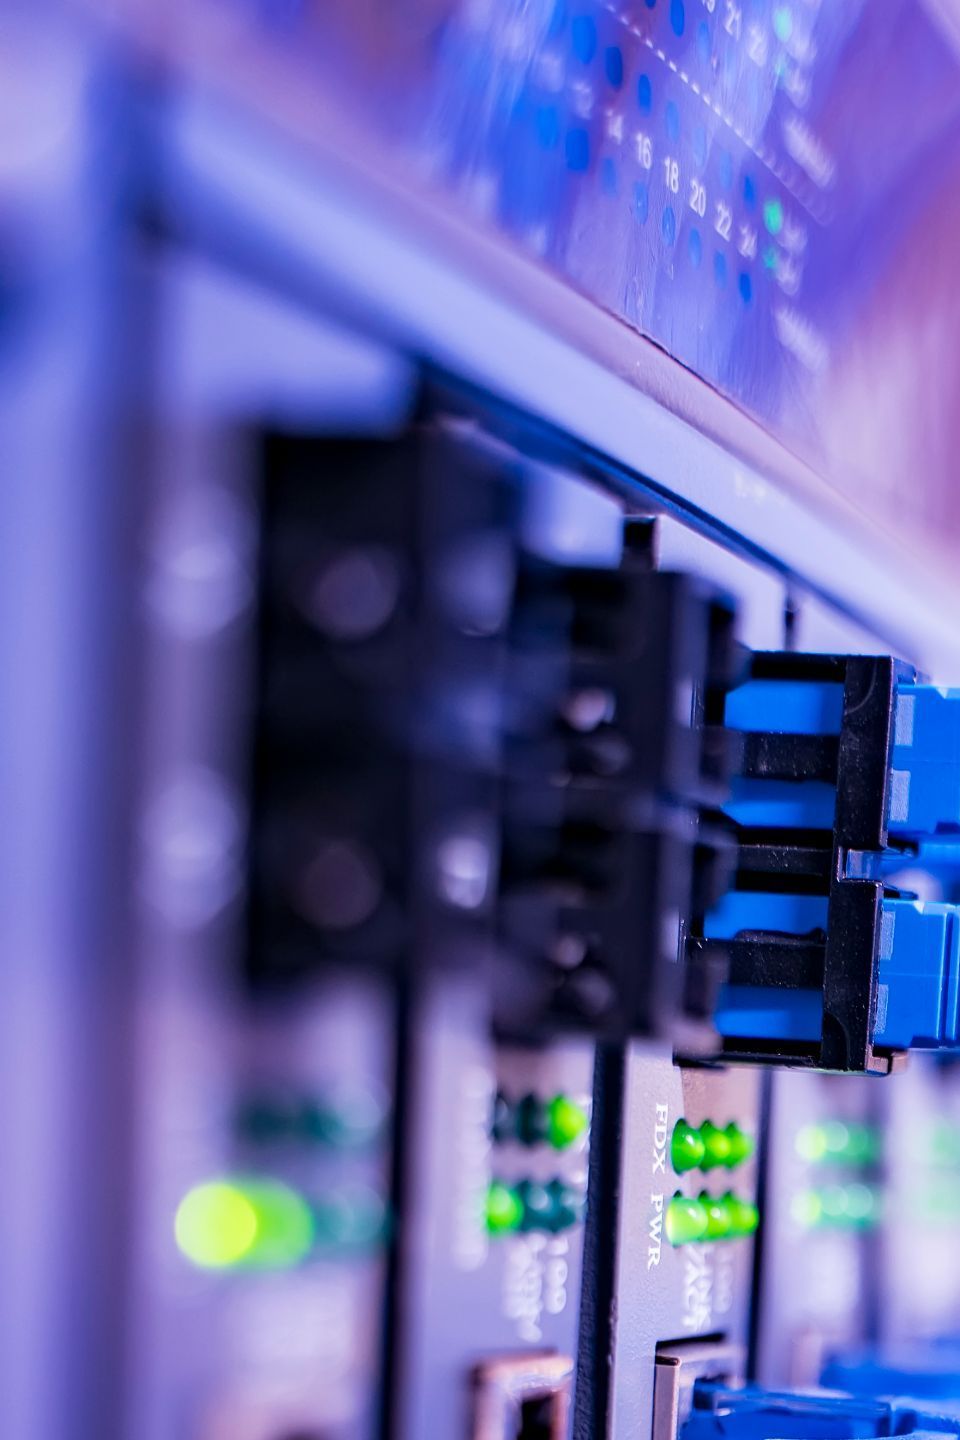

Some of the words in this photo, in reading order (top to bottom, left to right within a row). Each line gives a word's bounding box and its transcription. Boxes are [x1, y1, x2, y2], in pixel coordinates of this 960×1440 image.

[636, 132, 652, 170] 16
[664, 156, 679, 194] 18
[689, 178, 707, 219] 20
[715, 203, 732, 242] 22
[652, 1103, 669, 1175] FDX
[647, 1194, 665, 1271] PWR
